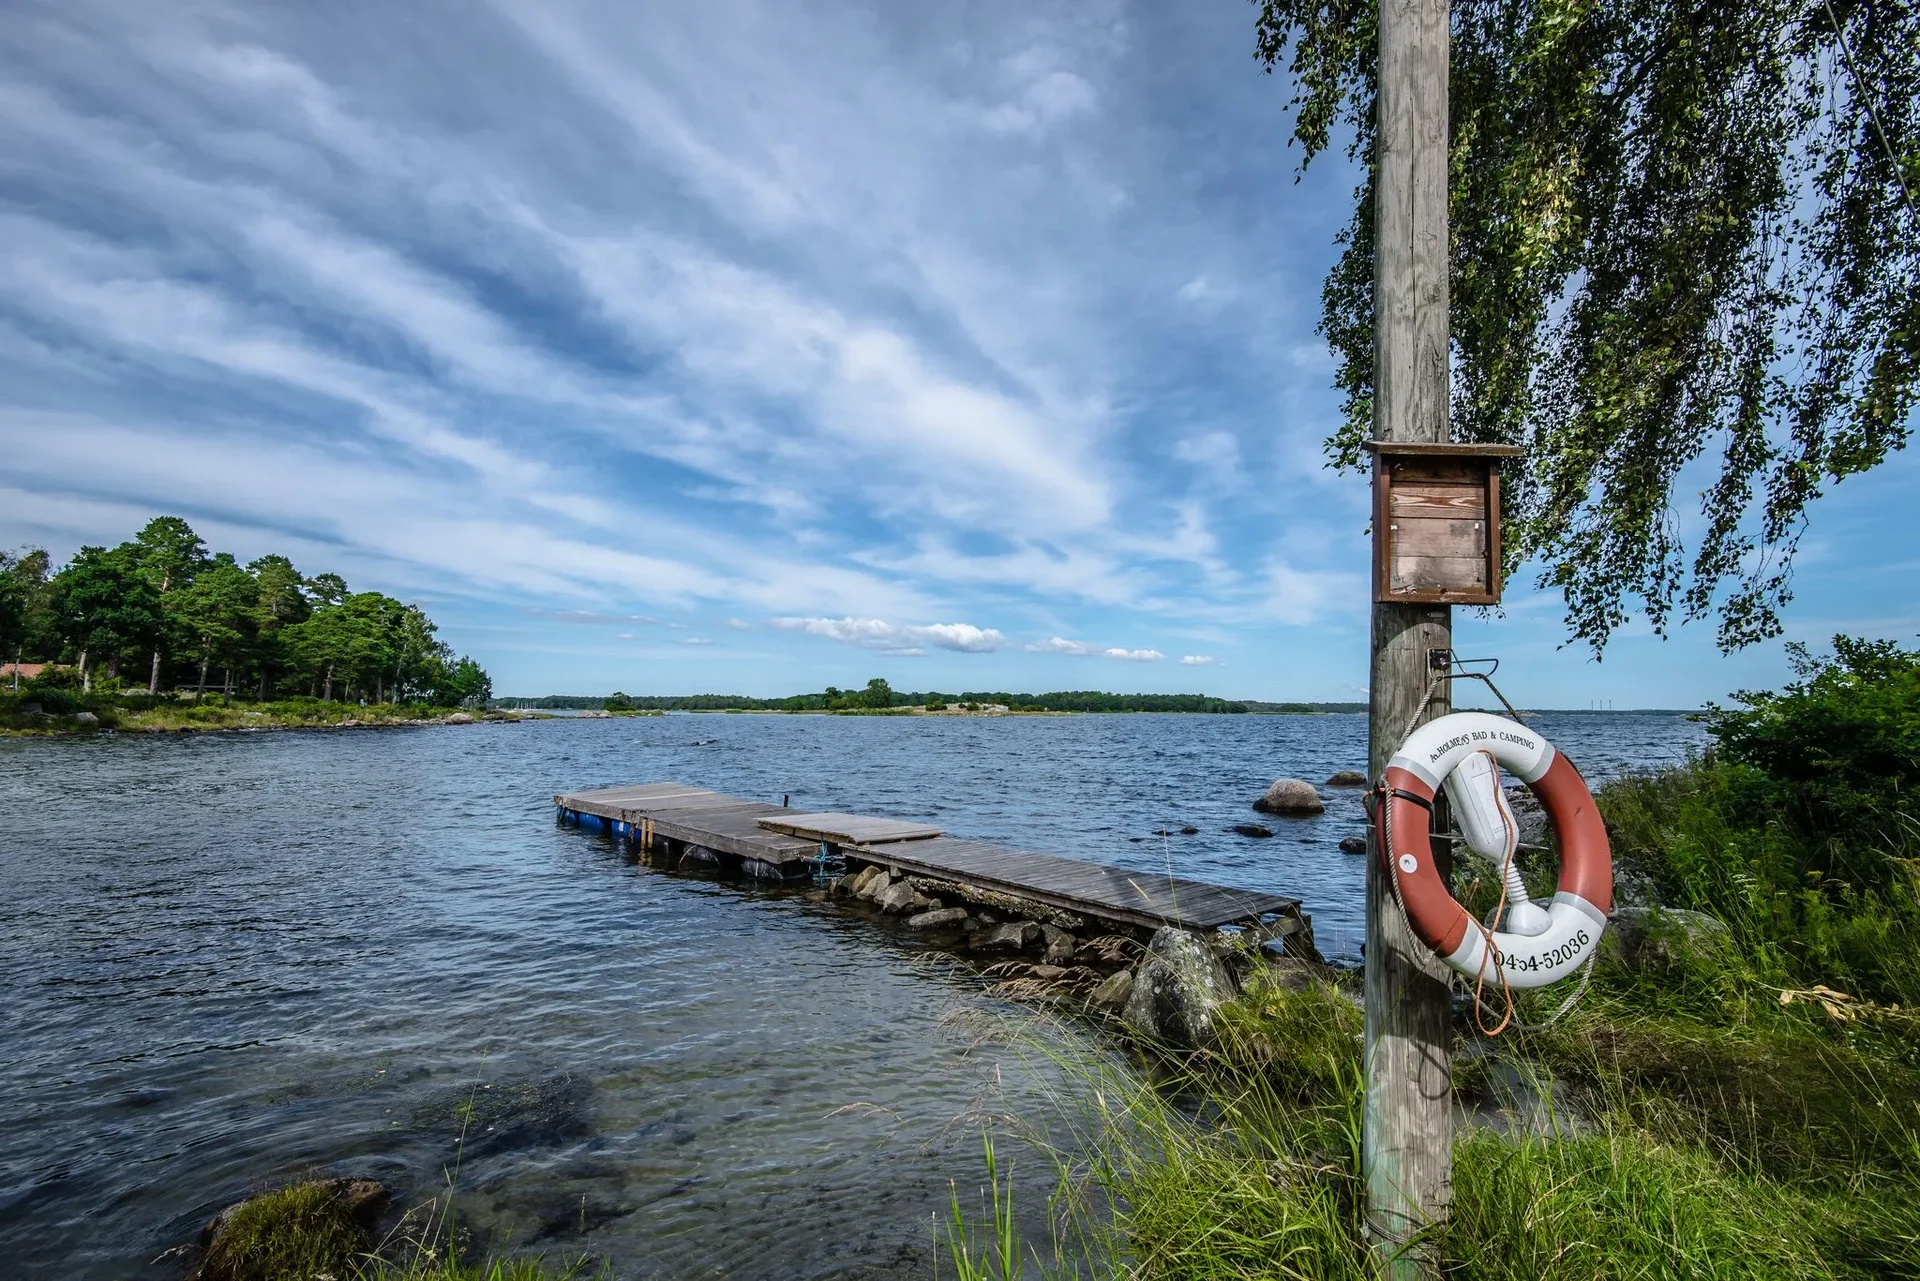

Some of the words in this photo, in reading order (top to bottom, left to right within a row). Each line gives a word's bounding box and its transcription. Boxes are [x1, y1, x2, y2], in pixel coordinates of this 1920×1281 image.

[1472, 731, 1488, 741] BAD
[1490, 731, 1497, 740] &
[1499, 731, 1535, 750] CAMPING
